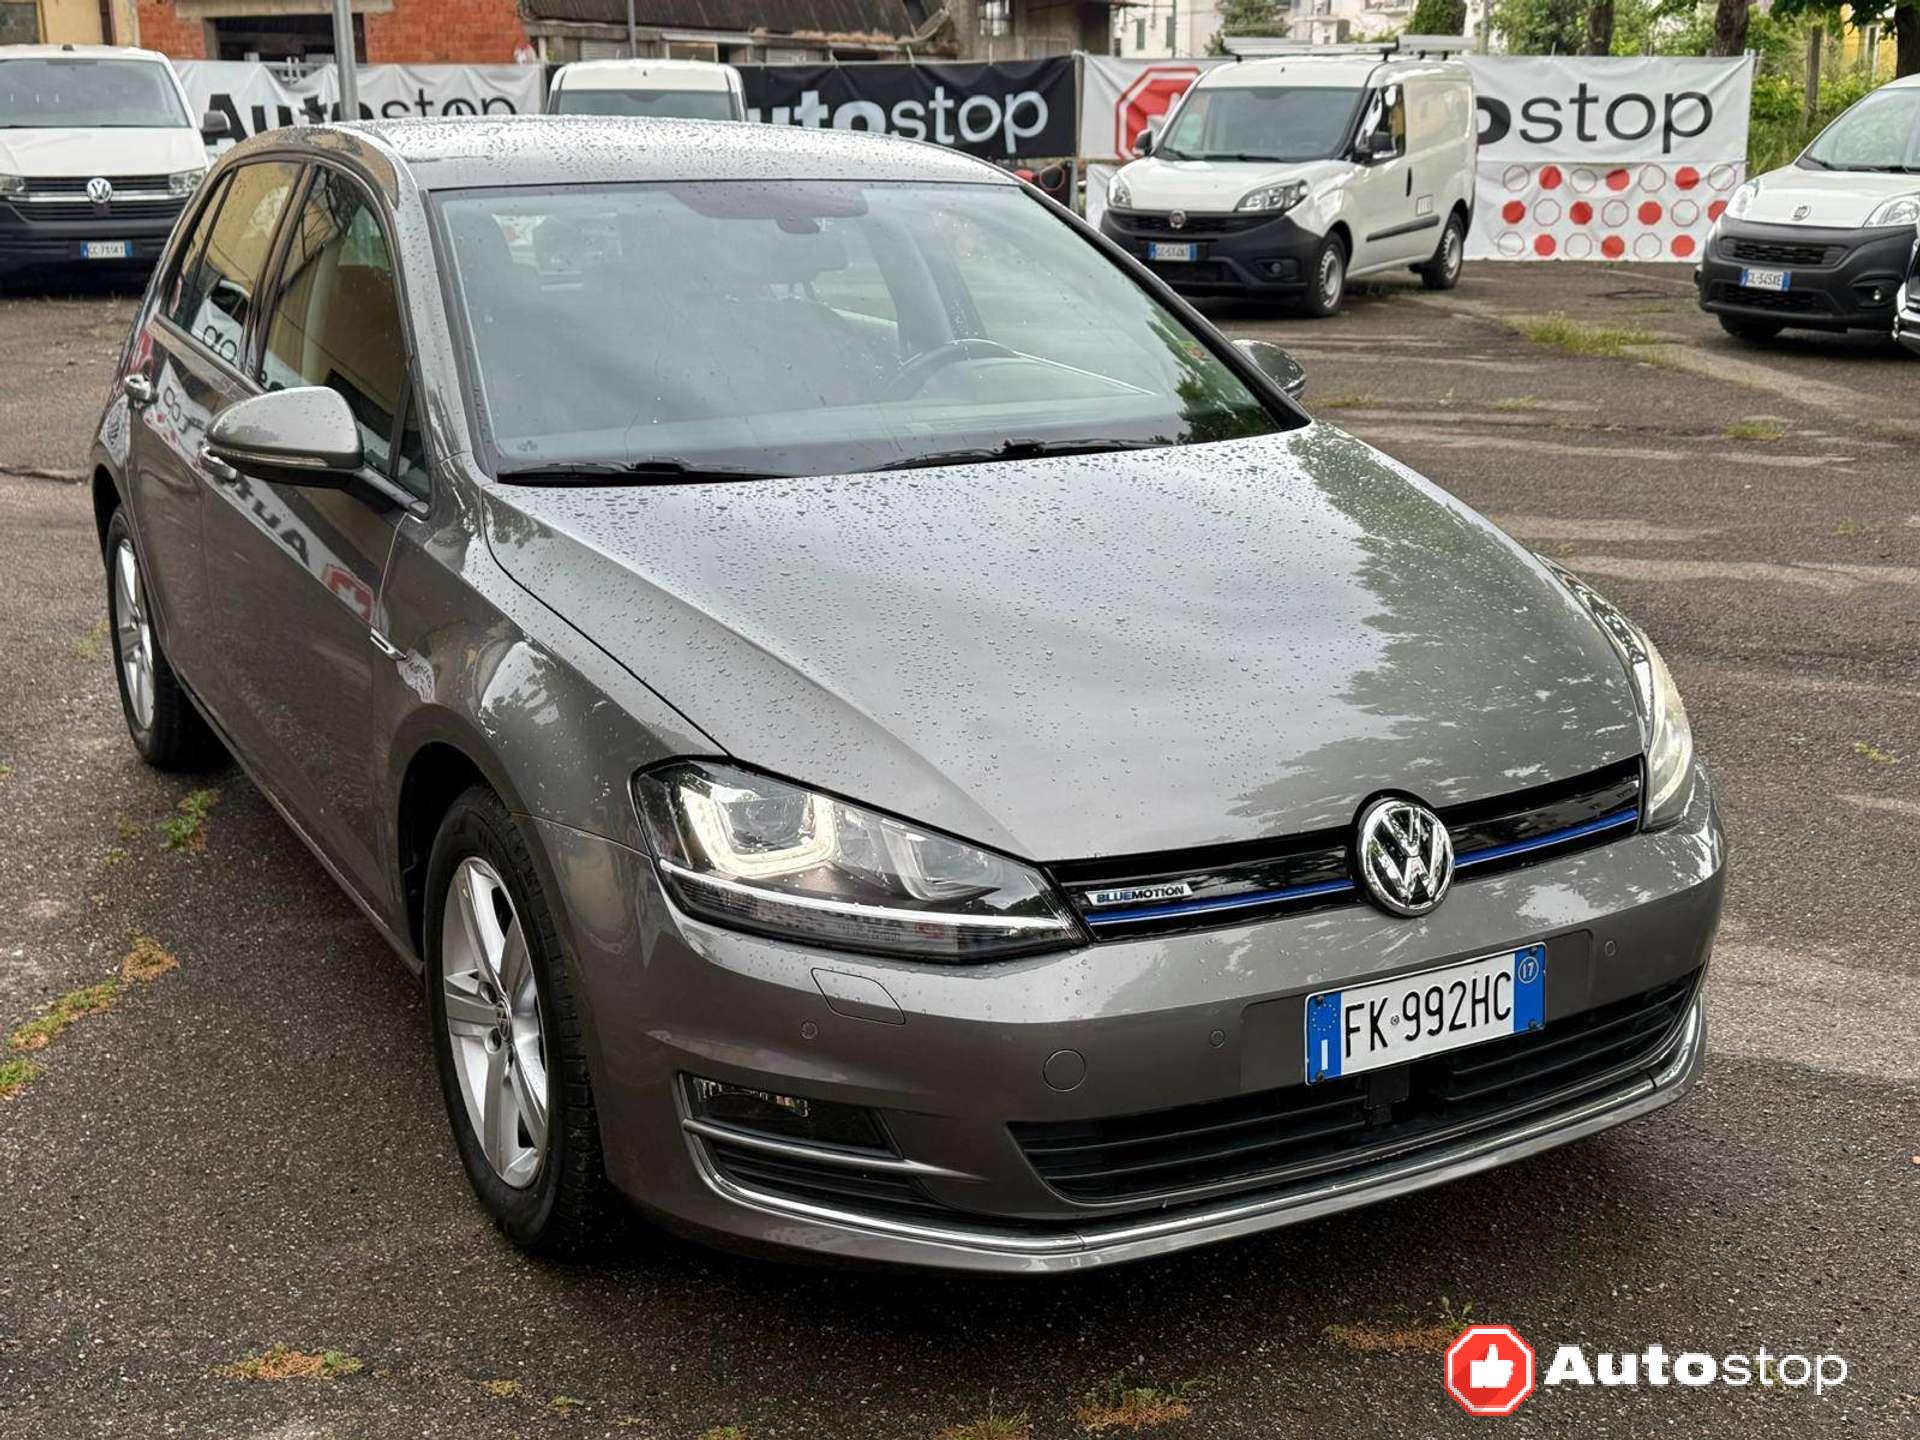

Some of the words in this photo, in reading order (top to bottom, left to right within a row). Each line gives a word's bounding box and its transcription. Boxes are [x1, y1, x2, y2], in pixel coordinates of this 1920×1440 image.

[202, 88, 517, 147] Autt
[1096, 885, 1185, 904] BLUEMOTION
[1519, 959, 1537, 981] 17
